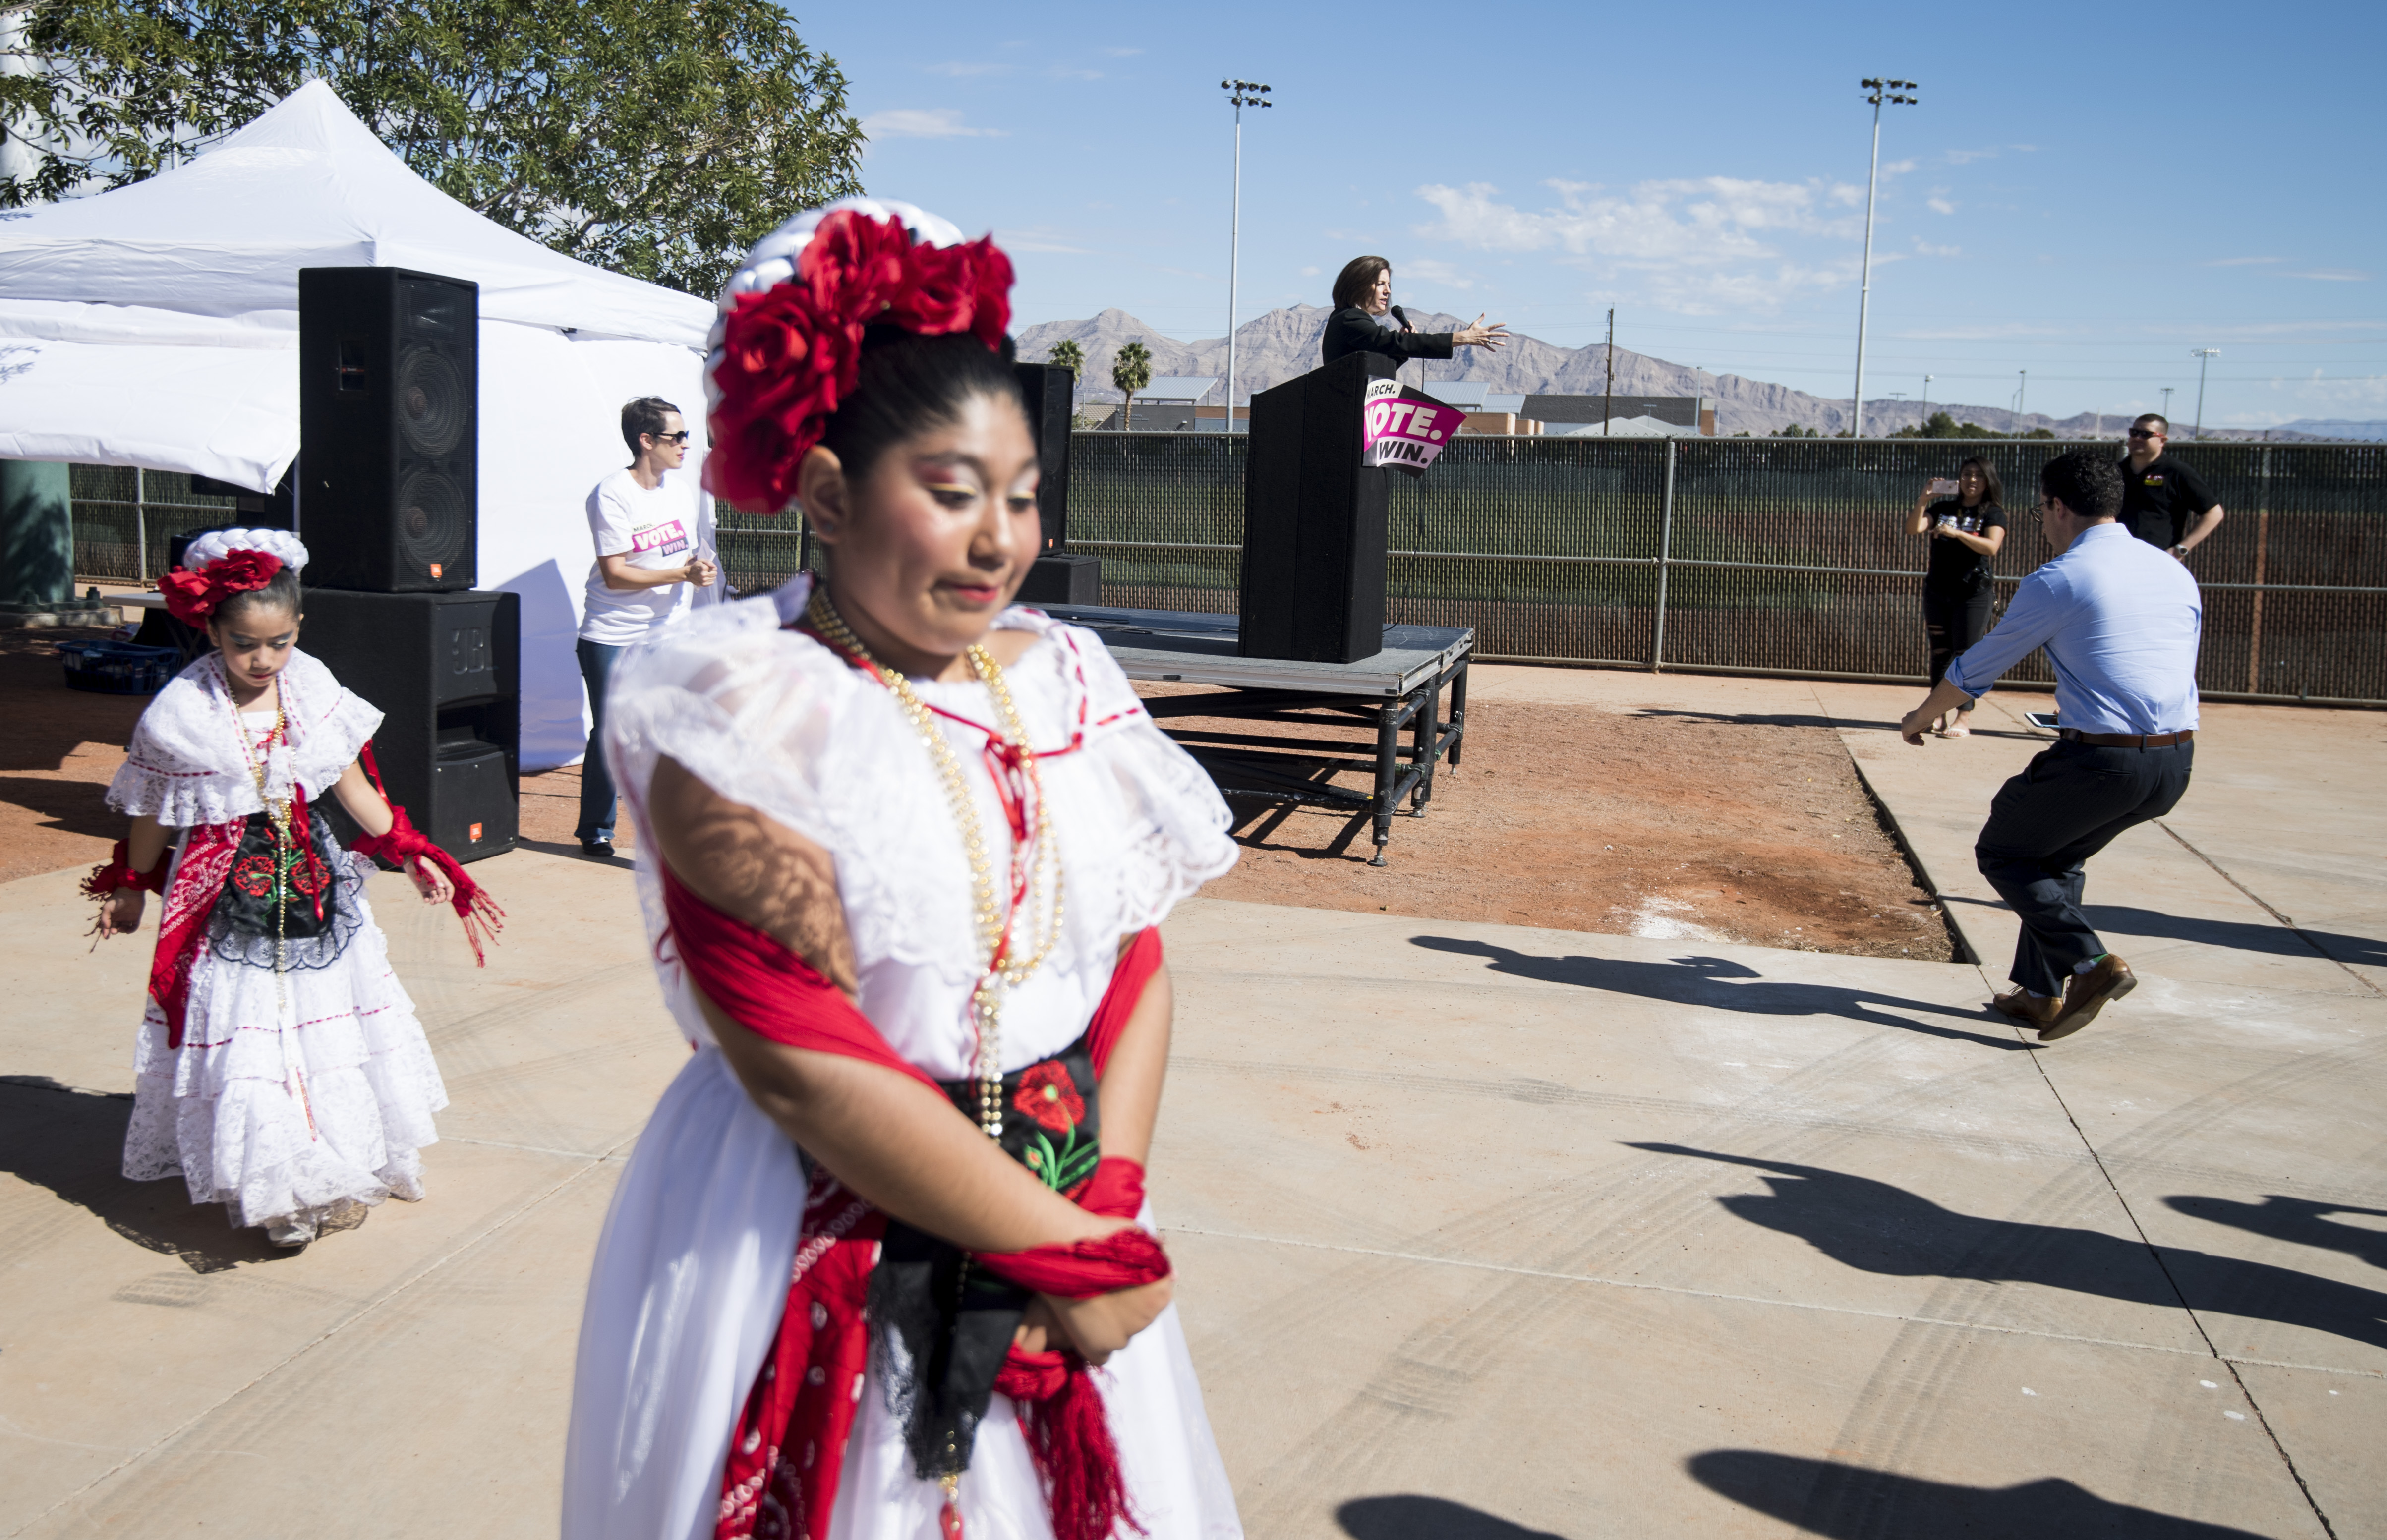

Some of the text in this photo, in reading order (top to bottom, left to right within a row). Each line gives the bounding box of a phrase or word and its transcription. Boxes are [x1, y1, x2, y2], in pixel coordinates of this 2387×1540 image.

[1366, 384, 1396, 400] MARCH.
[1365, 402, 1442, 442] VOTE.
[1379, 441, 1428, 464] WIN.
[634, 523, 685, 550] VOTE.
[662, 540, 688, 554] WIN.
